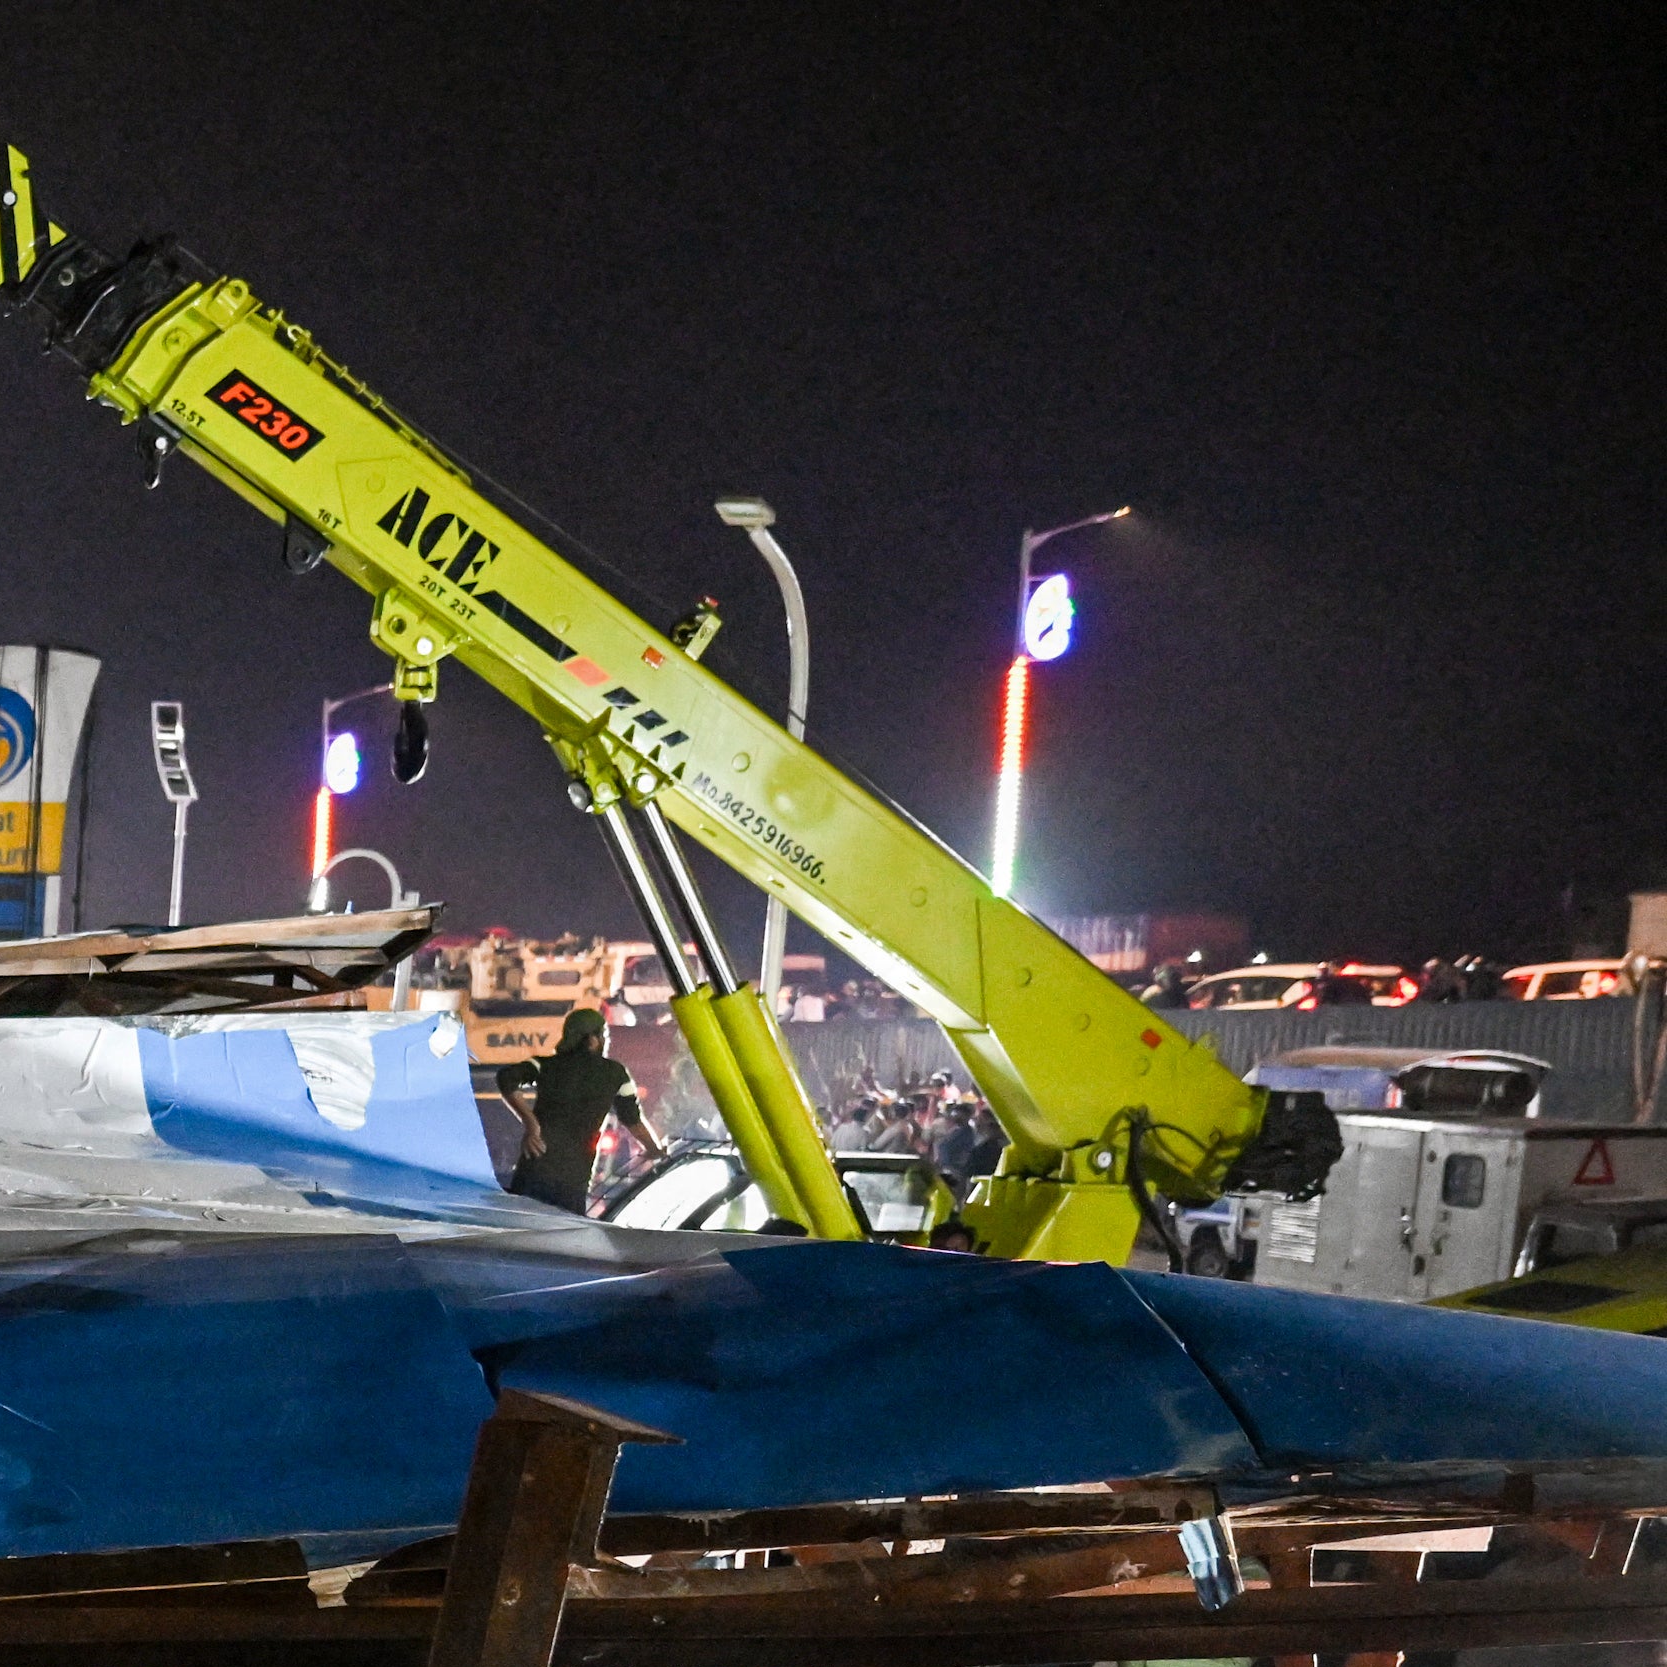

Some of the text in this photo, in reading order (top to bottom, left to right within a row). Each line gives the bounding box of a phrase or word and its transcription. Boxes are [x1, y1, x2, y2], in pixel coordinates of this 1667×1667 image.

[170, 399, 206, 428] 12.5T
[219, 381, 310, 450] F230
[376, 486, 501, 595] ACE
[419, 575, 446, 597] 20T
[449, 598, 477, 620] 23T
[486, 1032, 550, 1047] SANY
